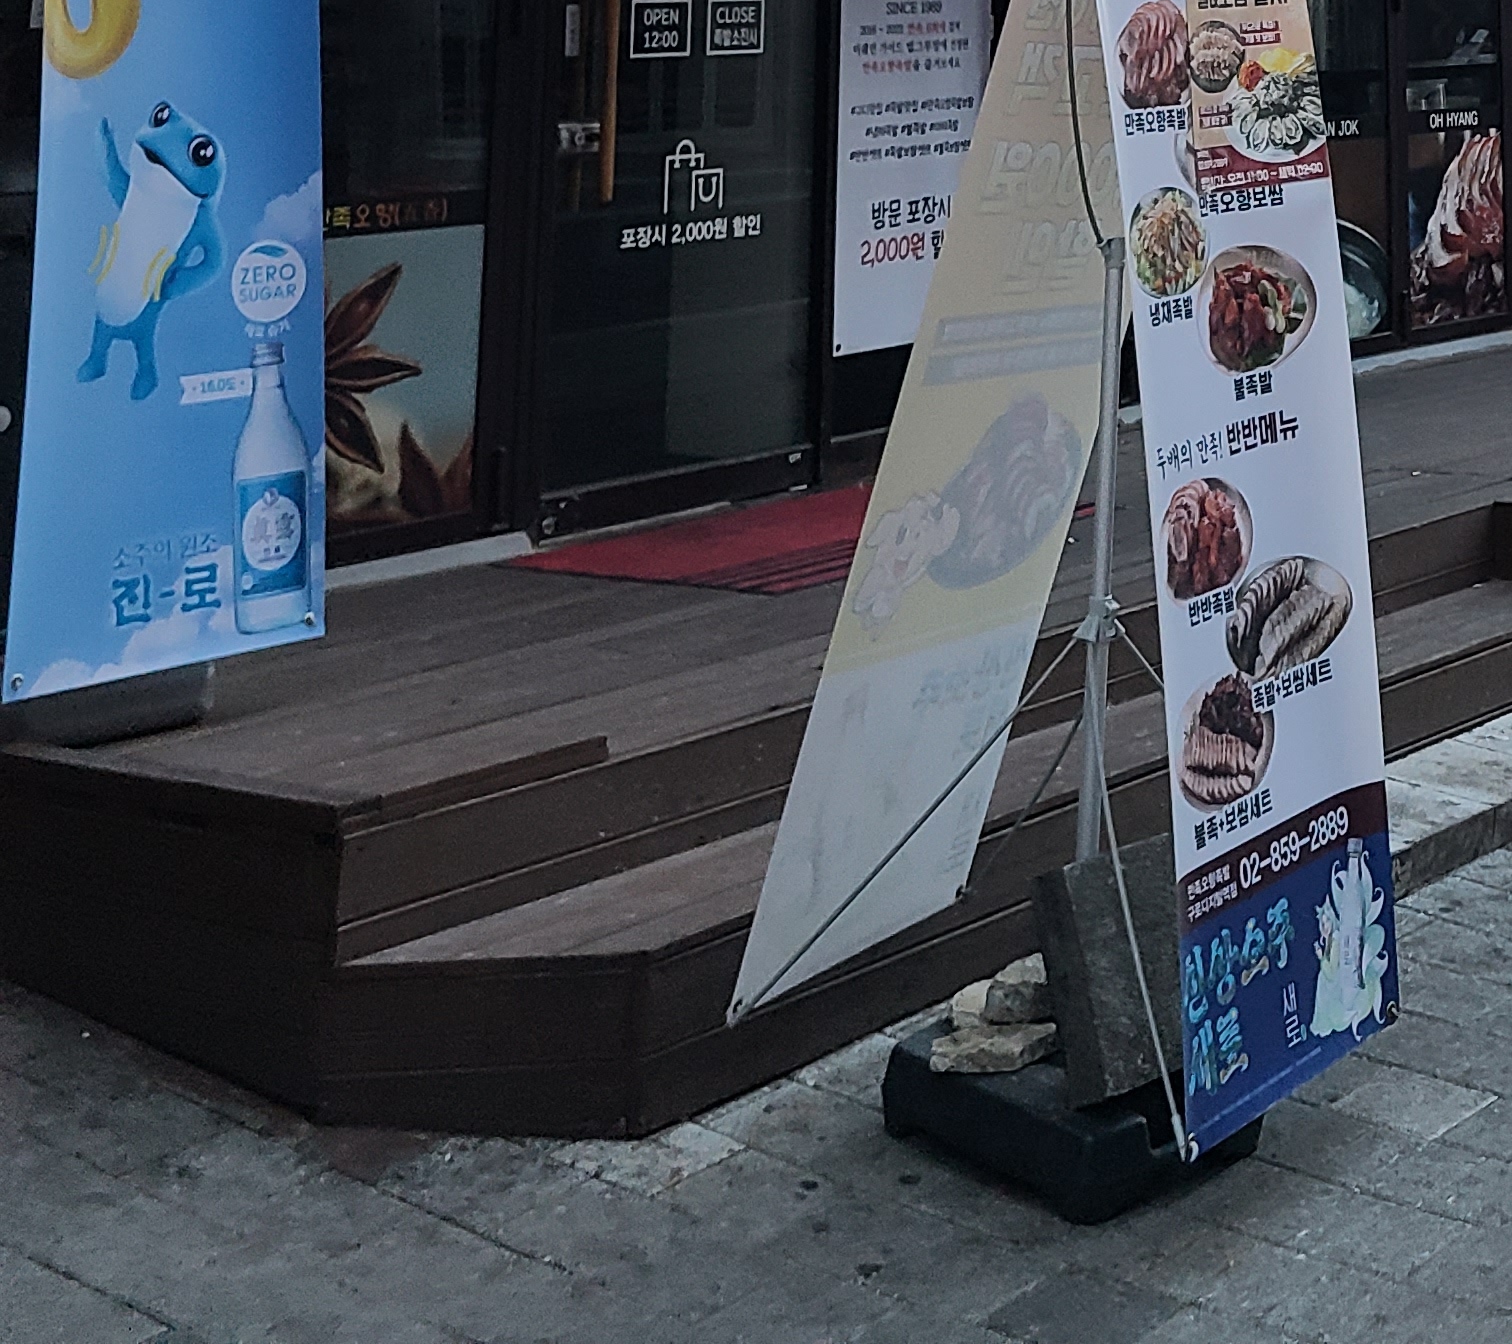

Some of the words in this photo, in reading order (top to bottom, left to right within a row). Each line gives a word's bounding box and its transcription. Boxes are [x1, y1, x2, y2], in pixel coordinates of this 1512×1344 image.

[643, 8, 680, 26] OPEN
[715, 6, 757, 24] CLOSE
[643, 30, 679, 49] 12:00
[1124, 108, 1188, 137] 만족오향족발
[1337, 119, 1360, 137] JOK
[1429, 113, 1444, 129] OH
[1446, 110, 1480, 128] HYANG
[871, 198, 902, 229] 방문
[906, 194, 952, 224] 포장시
[620, 224, 668, 250] 포장시
[670, 218, 729, 245] 2,000원
[732, 214, 762, 238] 할인
[860, 230, 926, 270] 2,000원
[239, 261, 298, 286] ZERO
[239, 283, 298, 305] SUGAR
[1149, 297, 1194, 328] 냉채족발
[1233, 369, 1273, 402] 불족발
[1156, 442, 1194, 480] 두배의
[1225, 410, 1300, 458] 반반메뉴
[1188, 585, 1236, 628] 반반족발
[1253, 657, 1334, 714] 족발+보쌈세트
[1192, 788, 1274, 852] 불족+보쌈세트
[1238, 804, 1350, 892] 02-859-2889
[1282, 984, 1302, 1048] 새로
